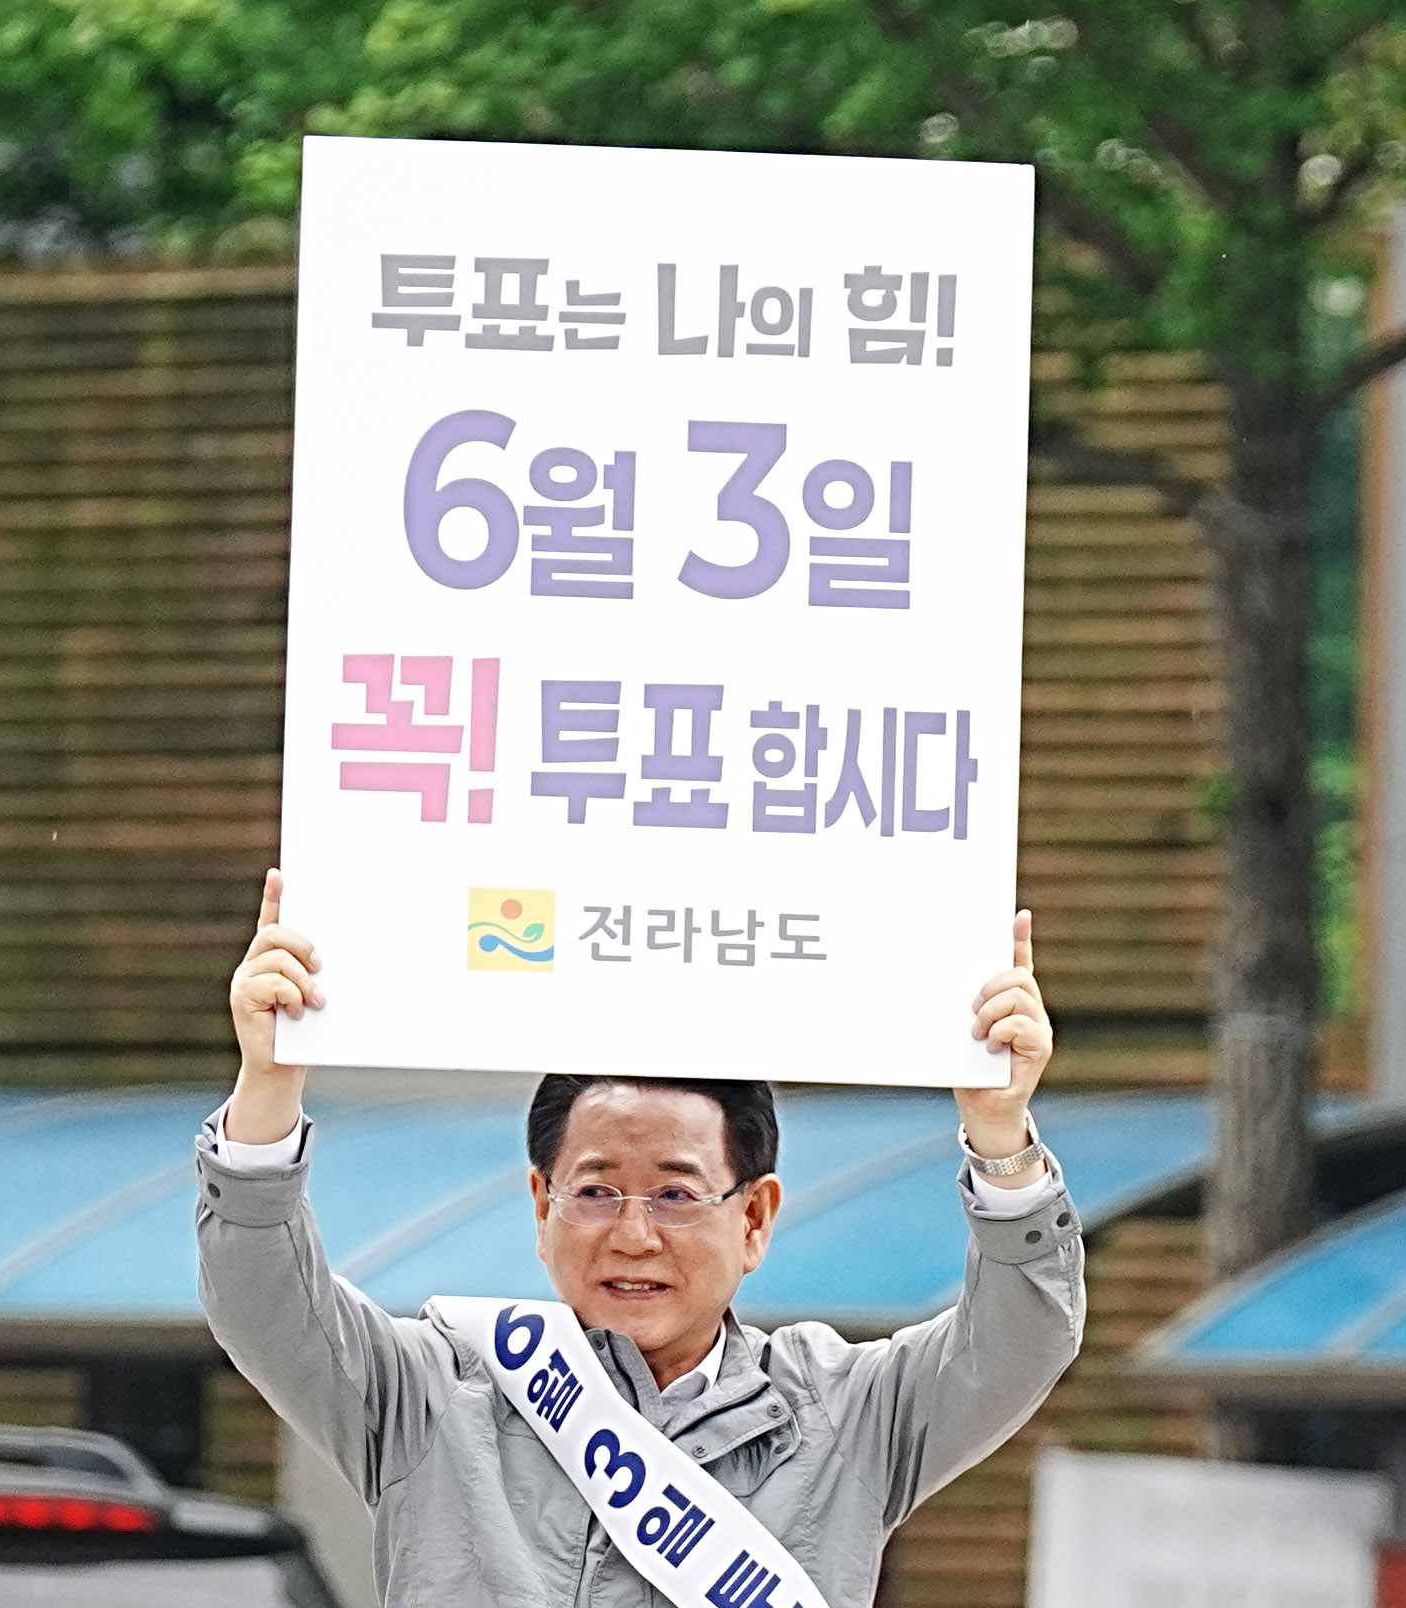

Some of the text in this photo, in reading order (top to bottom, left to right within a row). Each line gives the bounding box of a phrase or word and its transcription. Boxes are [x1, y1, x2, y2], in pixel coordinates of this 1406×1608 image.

[371, 253, 958, 368] 투표는 나의 힘!
[403, 409, 913, 610] 6월 3일
[330, 653, 979, 841] 꼭! 투표 합시다
[578, 905, 828, 967] 전라남도
[494, 1303, 584, 1433] 6월
[584, 1428, 716, 1569] 3일
